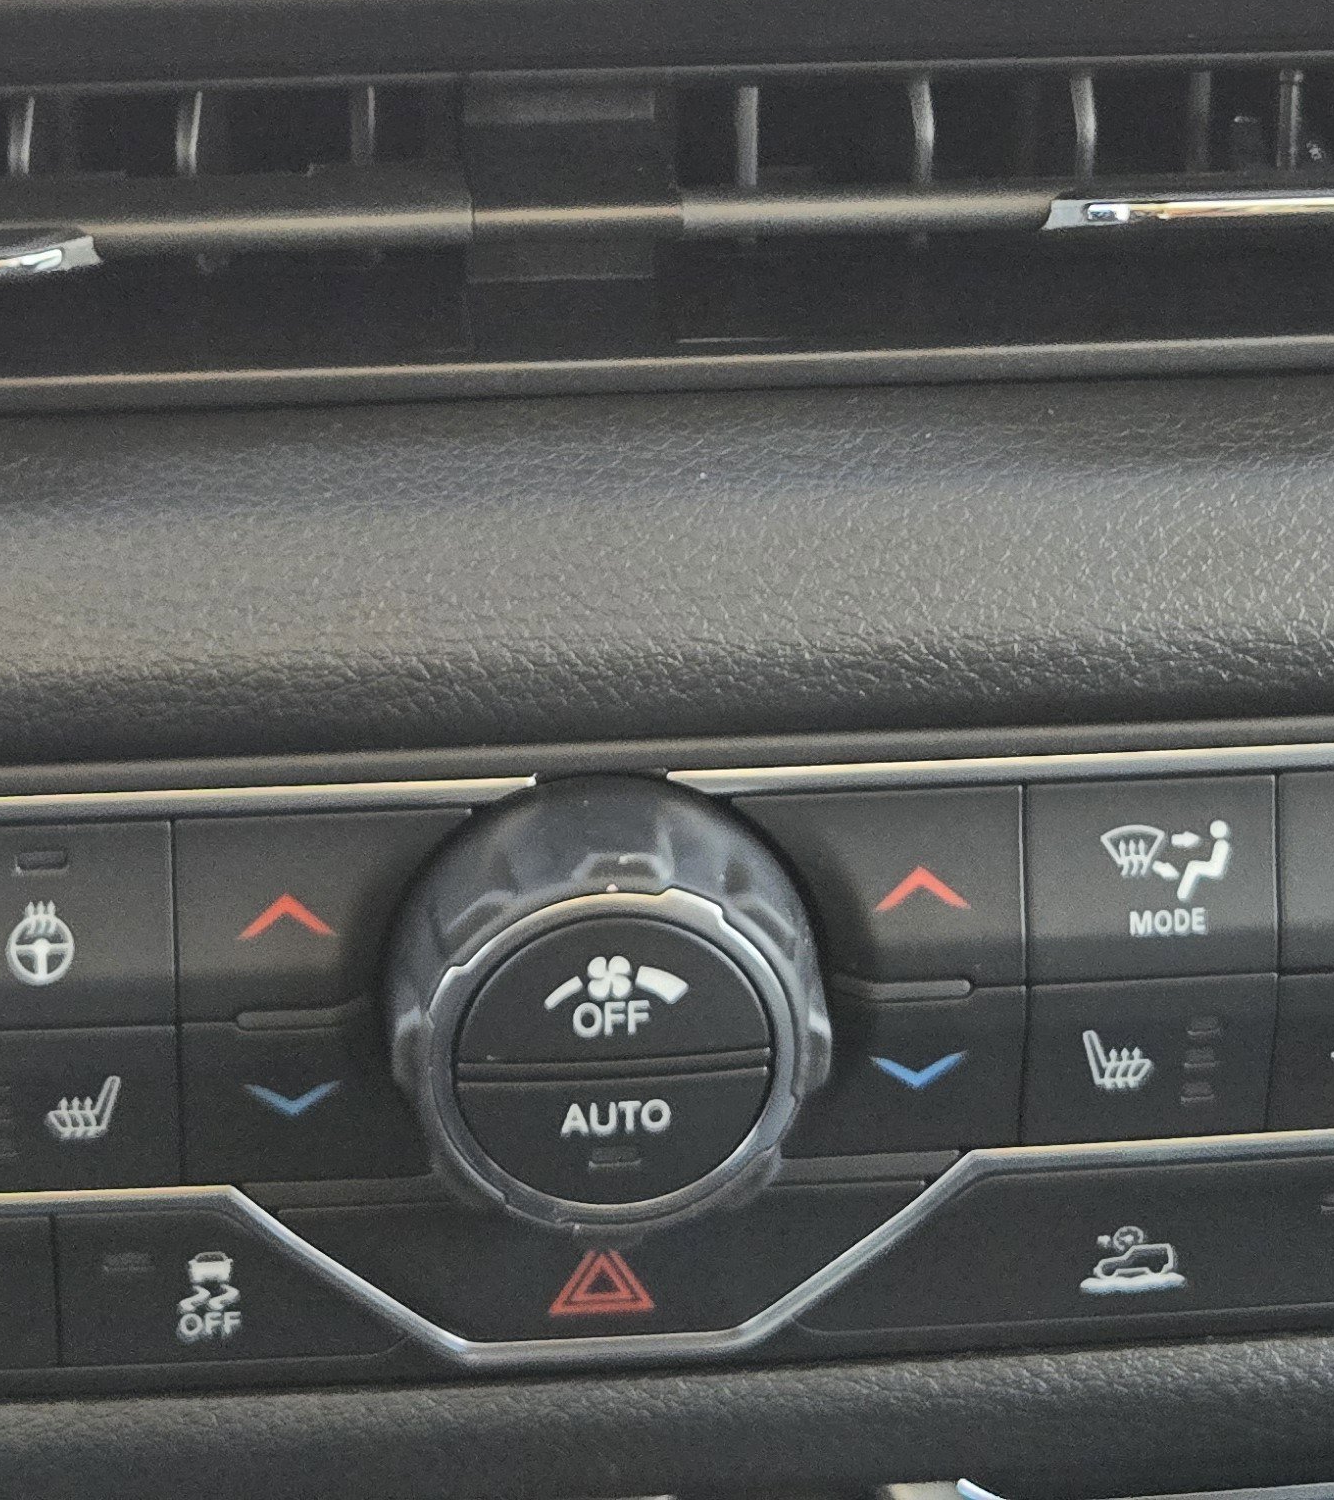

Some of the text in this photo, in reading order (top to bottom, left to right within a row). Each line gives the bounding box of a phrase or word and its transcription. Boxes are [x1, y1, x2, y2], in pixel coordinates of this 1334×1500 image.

[1128, 908, 1207, 936] MODE
[572, 1001, 651, 1039] OFF
[561, 1098, 671, 1138] AUTO
[178, 1308, 241, 1340] OFF
